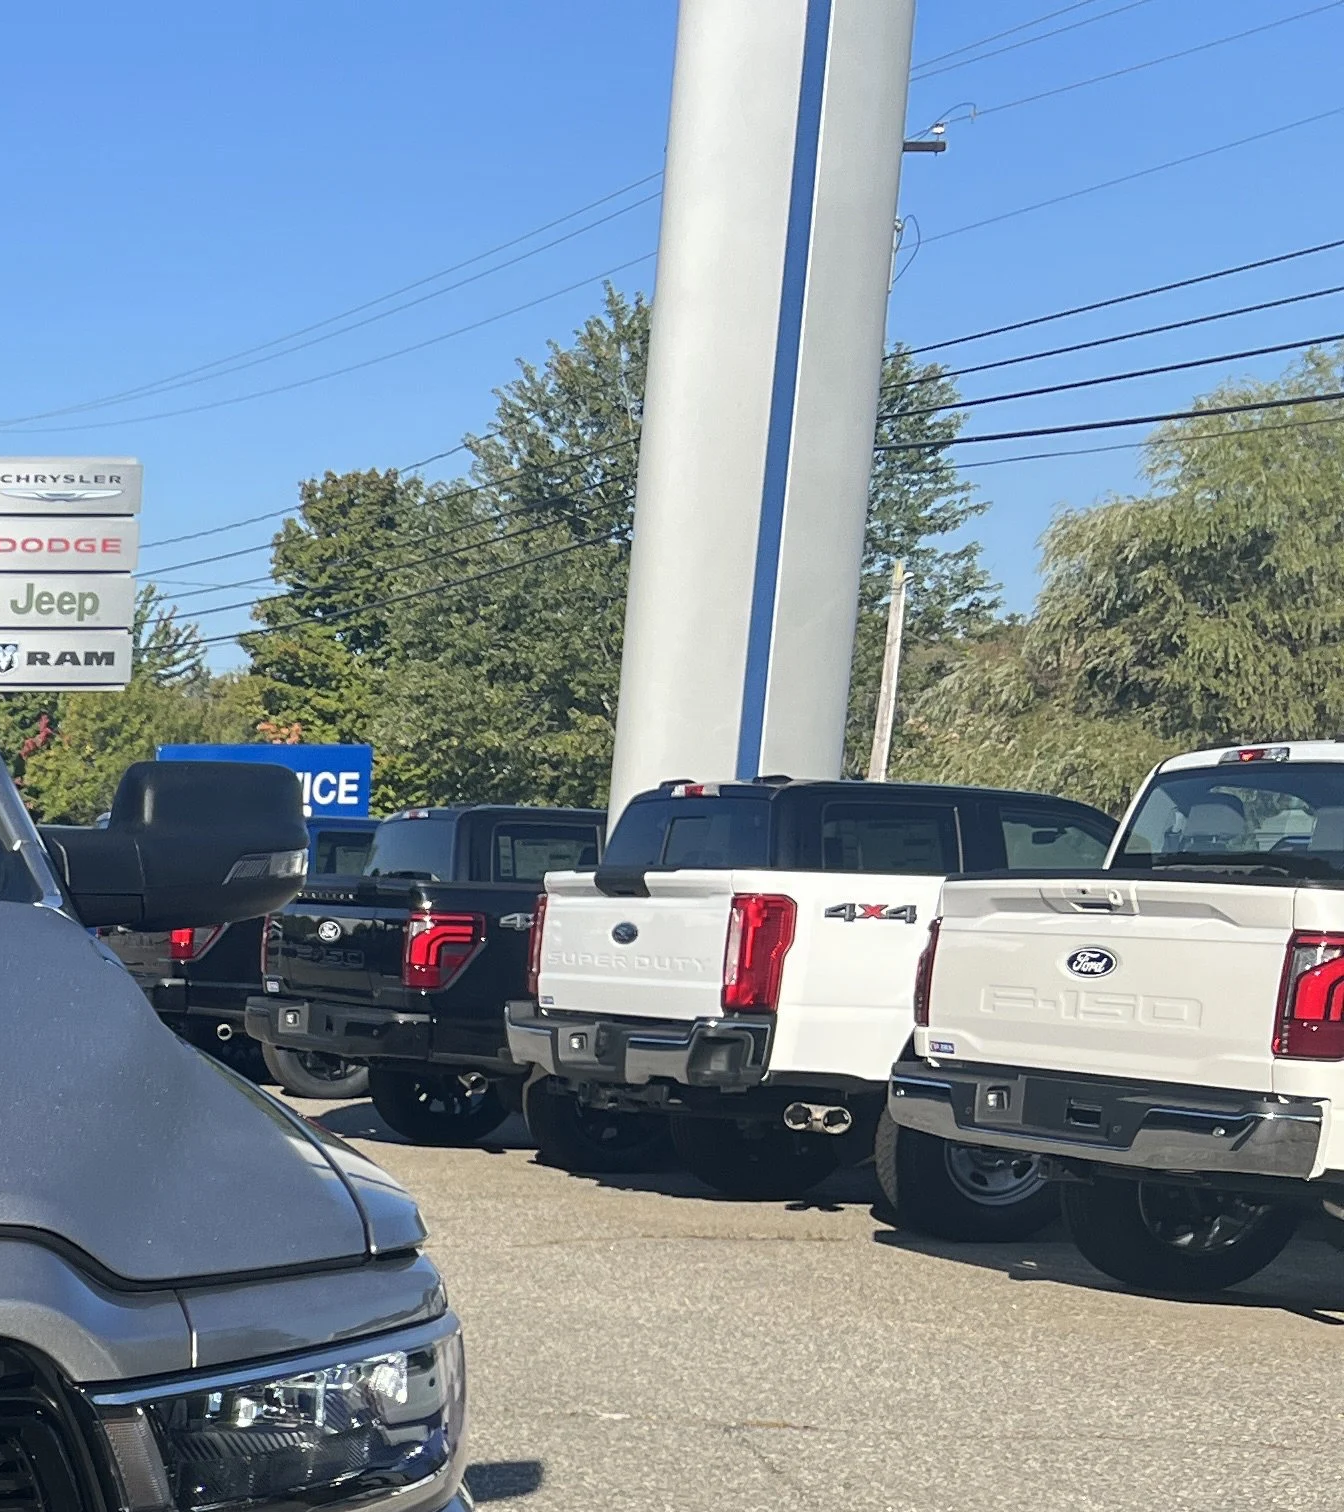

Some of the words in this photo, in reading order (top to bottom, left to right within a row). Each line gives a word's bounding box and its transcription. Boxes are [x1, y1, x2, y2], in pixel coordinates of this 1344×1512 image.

[0, 474, 122, 484] CHRYSLER
[10, 582, 100, 622] Jeep
[26, 651, 115, 666] RAM
[296, 771, 360, 805] ICE
[548, 952, 628, 969] SUPER
[634, 956, 706, 973] DUTY
[979, 984, 1203, 1029] F-150
